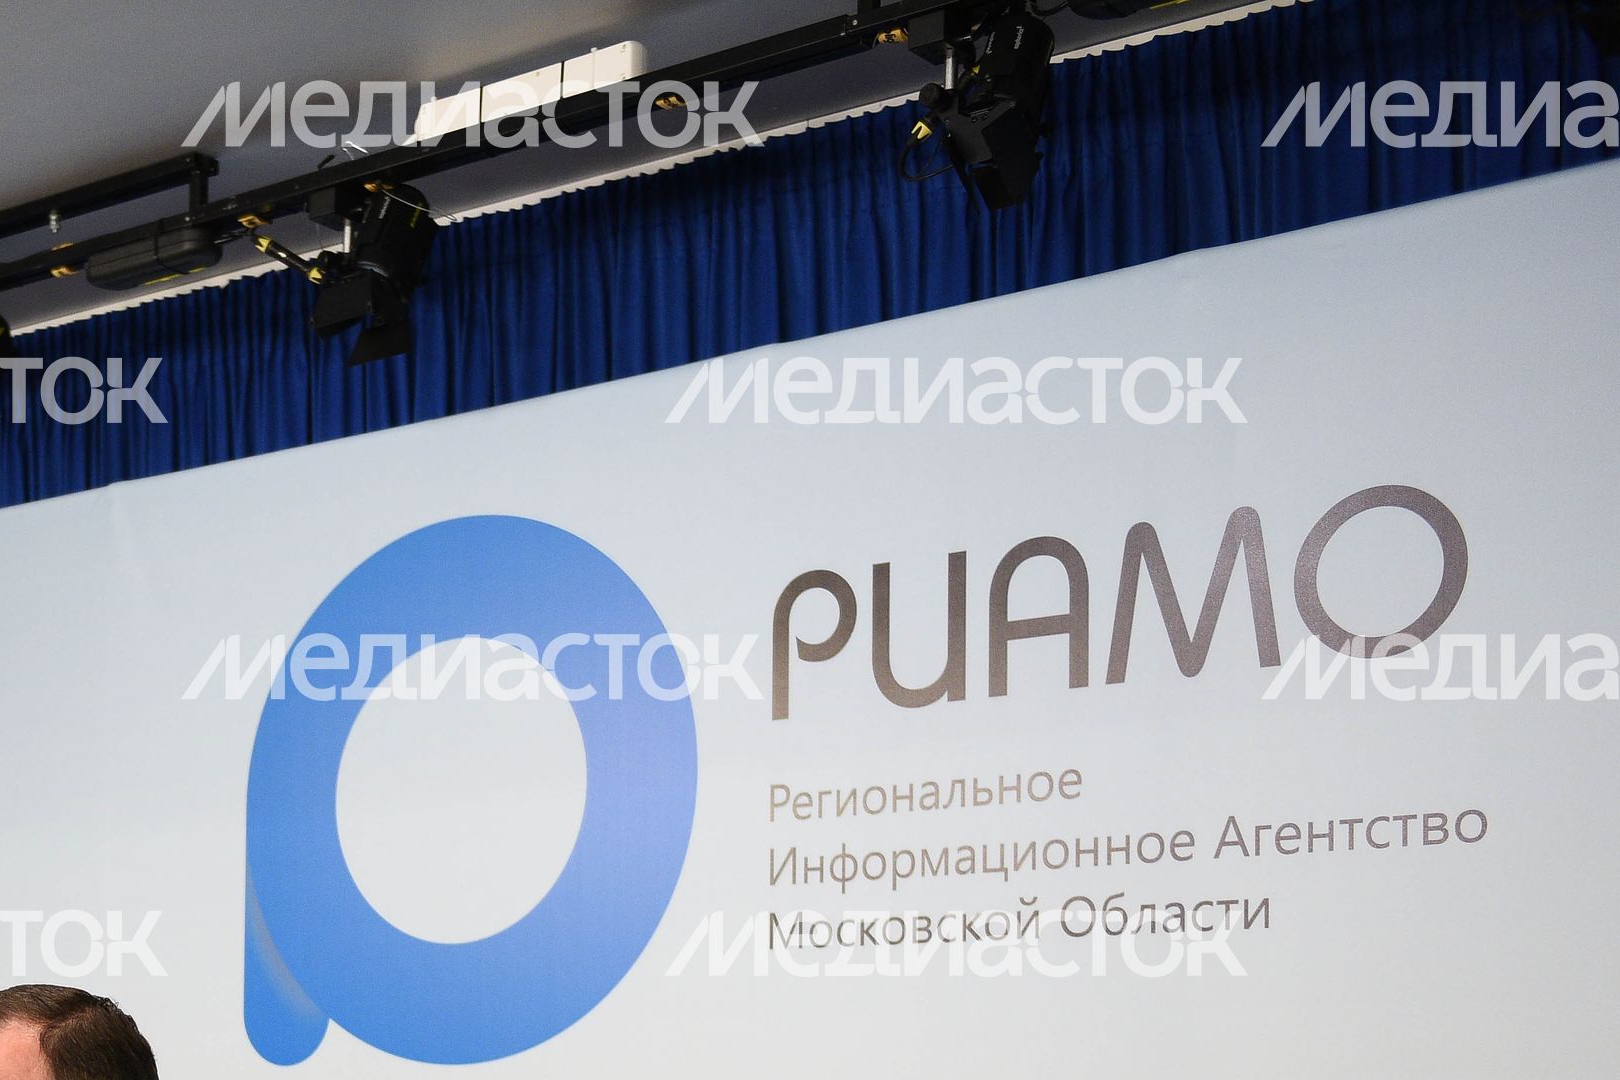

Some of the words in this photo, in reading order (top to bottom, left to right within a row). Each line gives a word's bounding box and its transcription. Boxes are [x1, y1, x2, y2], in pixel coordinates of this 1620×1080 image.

[772, 484, 1469, 720] РИАМО
[769, 767, 1083, 822] Региональное
[769, 828, 1196, 894] Информационное
[1213, 808, 1489, 860] Агентство
[769, 896, 1042, 950] Московской
[1060, 891, 1270, 938] Области
